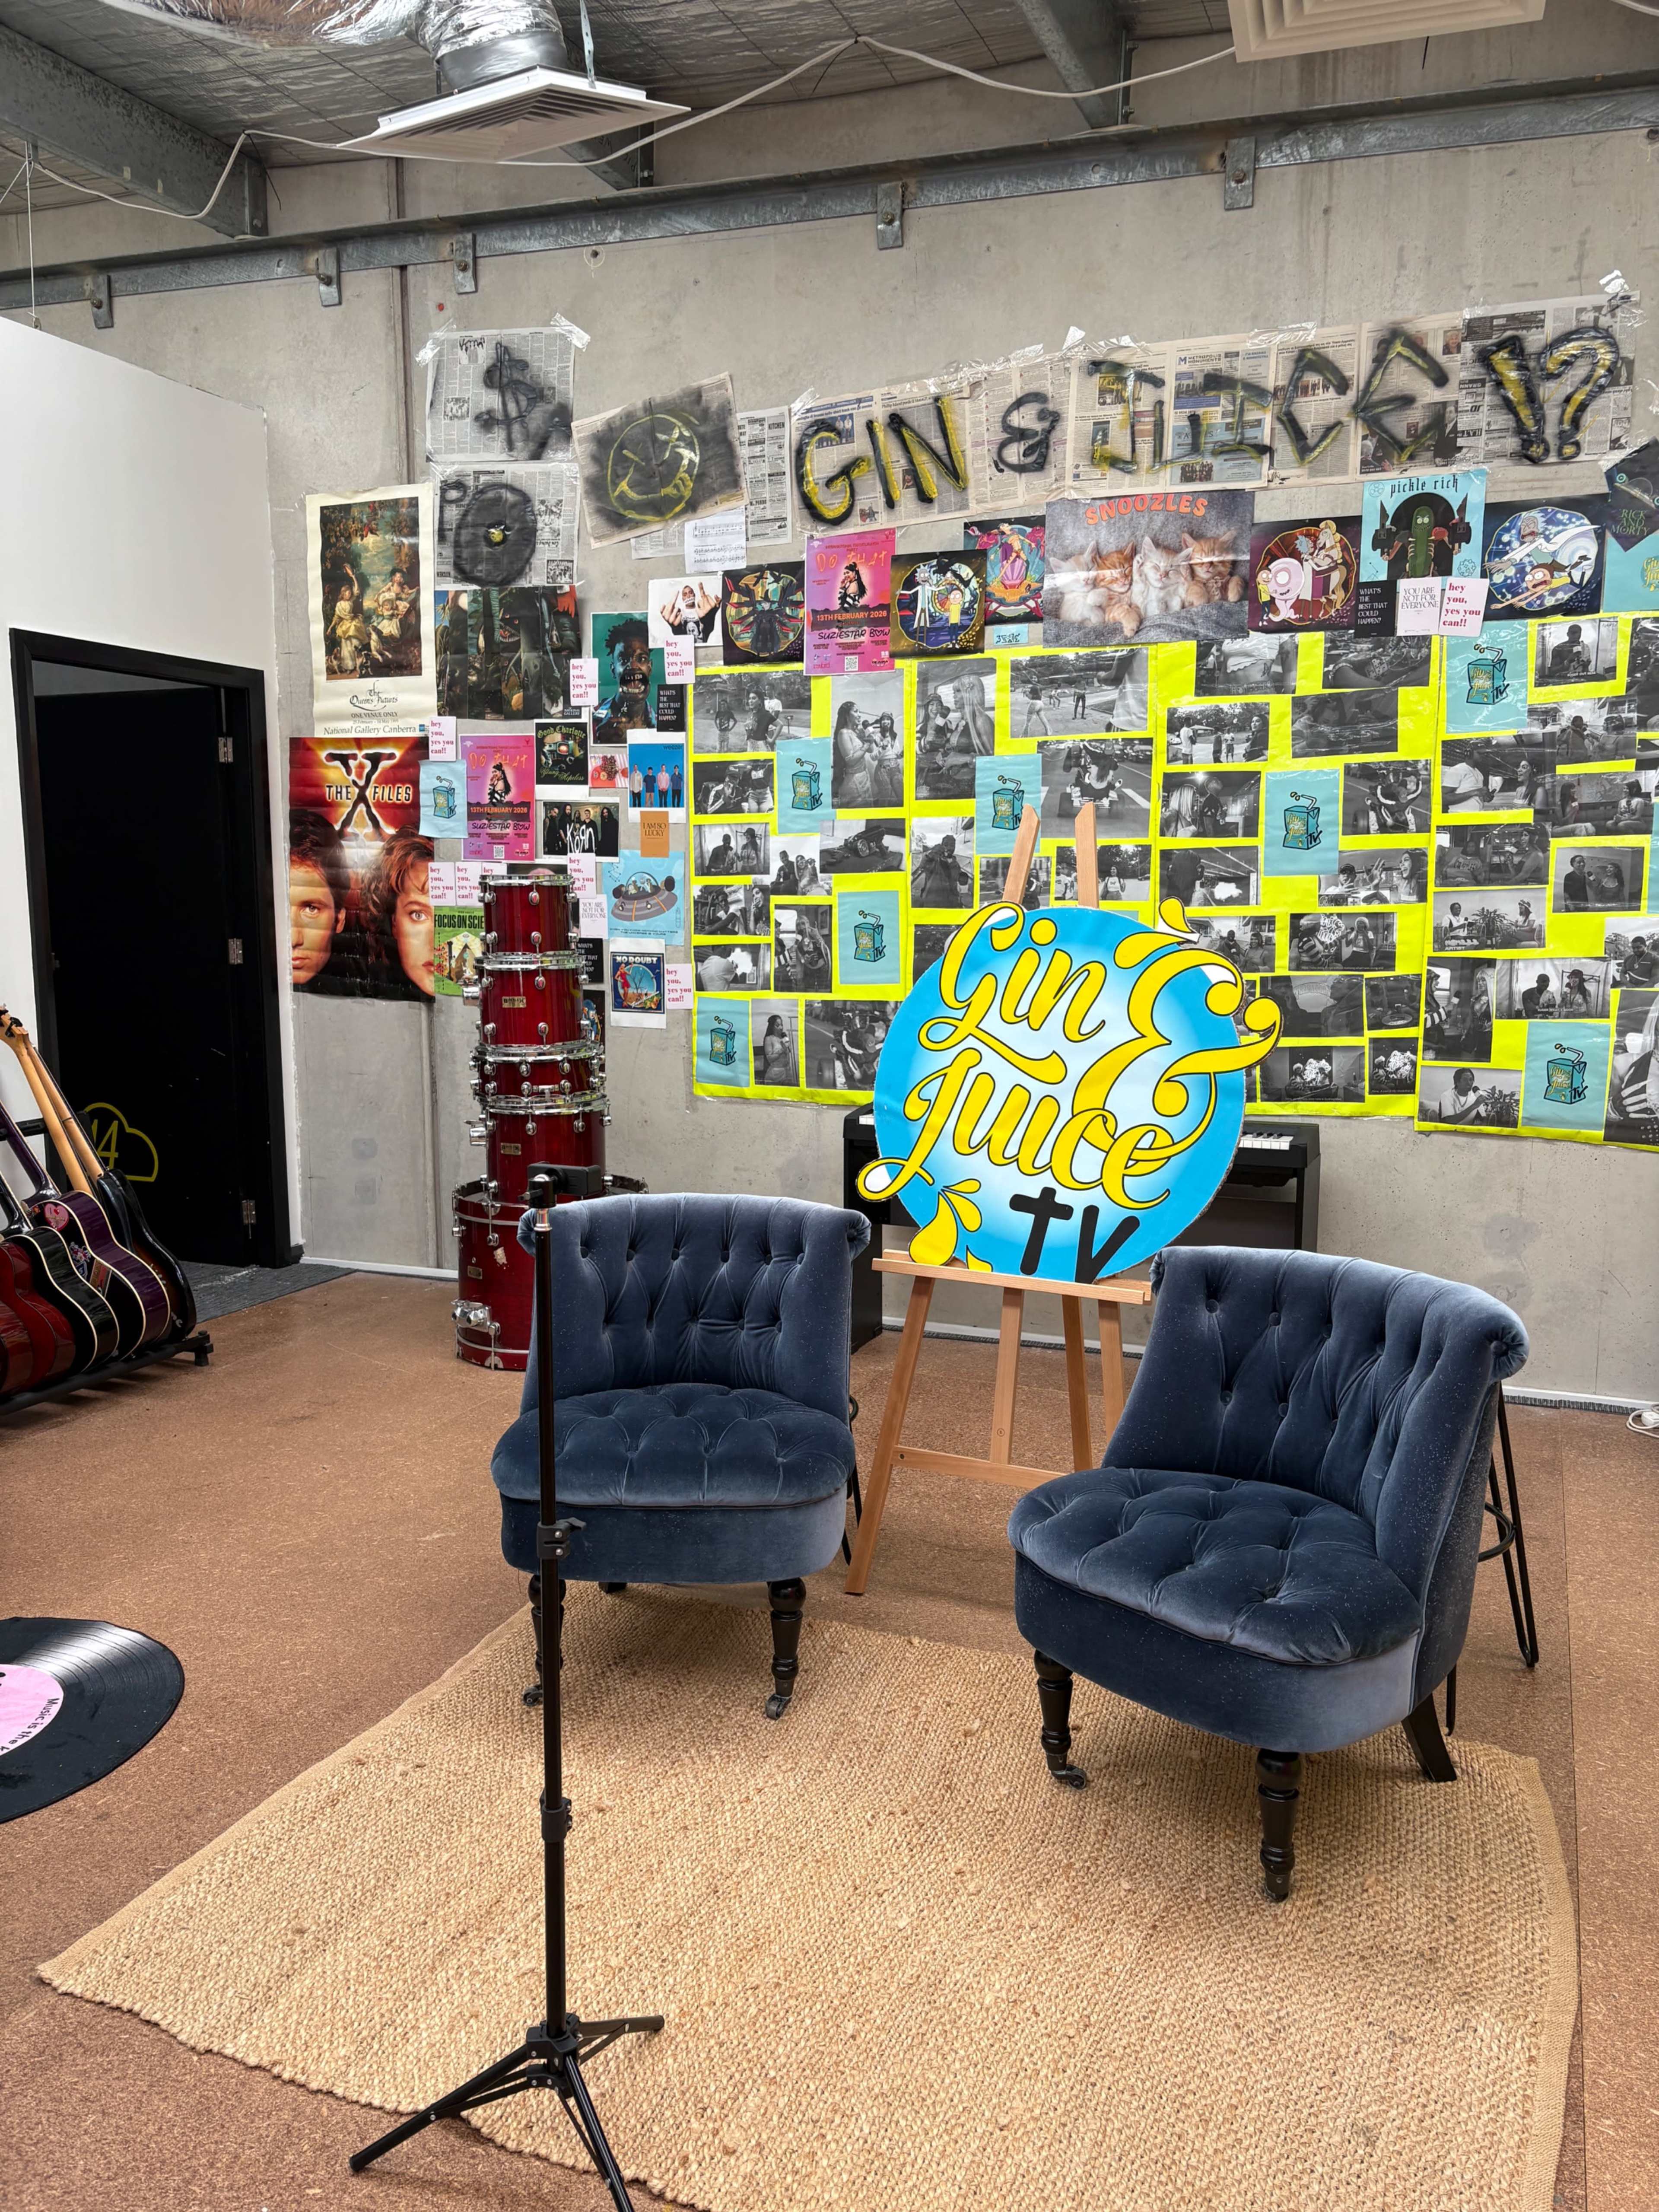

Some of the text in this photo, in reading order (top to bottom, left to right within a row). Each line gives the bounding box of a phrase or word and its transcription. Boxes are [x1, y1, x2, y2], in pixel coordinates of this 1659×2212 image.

[768, 422, 785, 430] KITCHEN
[795, 397, 969, 525] GIN
[1390, 475, 1458, 499] pickle rick
[1086, 493, 1208, 525] SNOOZLES
[1621, 509, 1646, 519] RICK
[1620, 518, 1645, 528] AND
[1611, 525, 1650, 535] MORTY
[1448, 583, 1465, 593] hey
[1401, 601, 1440, 609] EVERYONE
[834, 612, 868, 621] FEBRUARY
[1444, 608, 1481, 617] yes you
[324, 726, 353, 735] National
[354, 726, 381, 735] Gallery
[537, 726, 554, 738] Good
[324, 752, 411, 840] THE X FILES
[434, 914, 456, 928] FOCUS
[457, 914, 467, 929] ON
[918, 902, 1106, 1085] Gin
[856, 1047, 1174, 1209] Juice
[35, 1698, 60, 1722] Music
[9, 1731, 32, 1744] the
